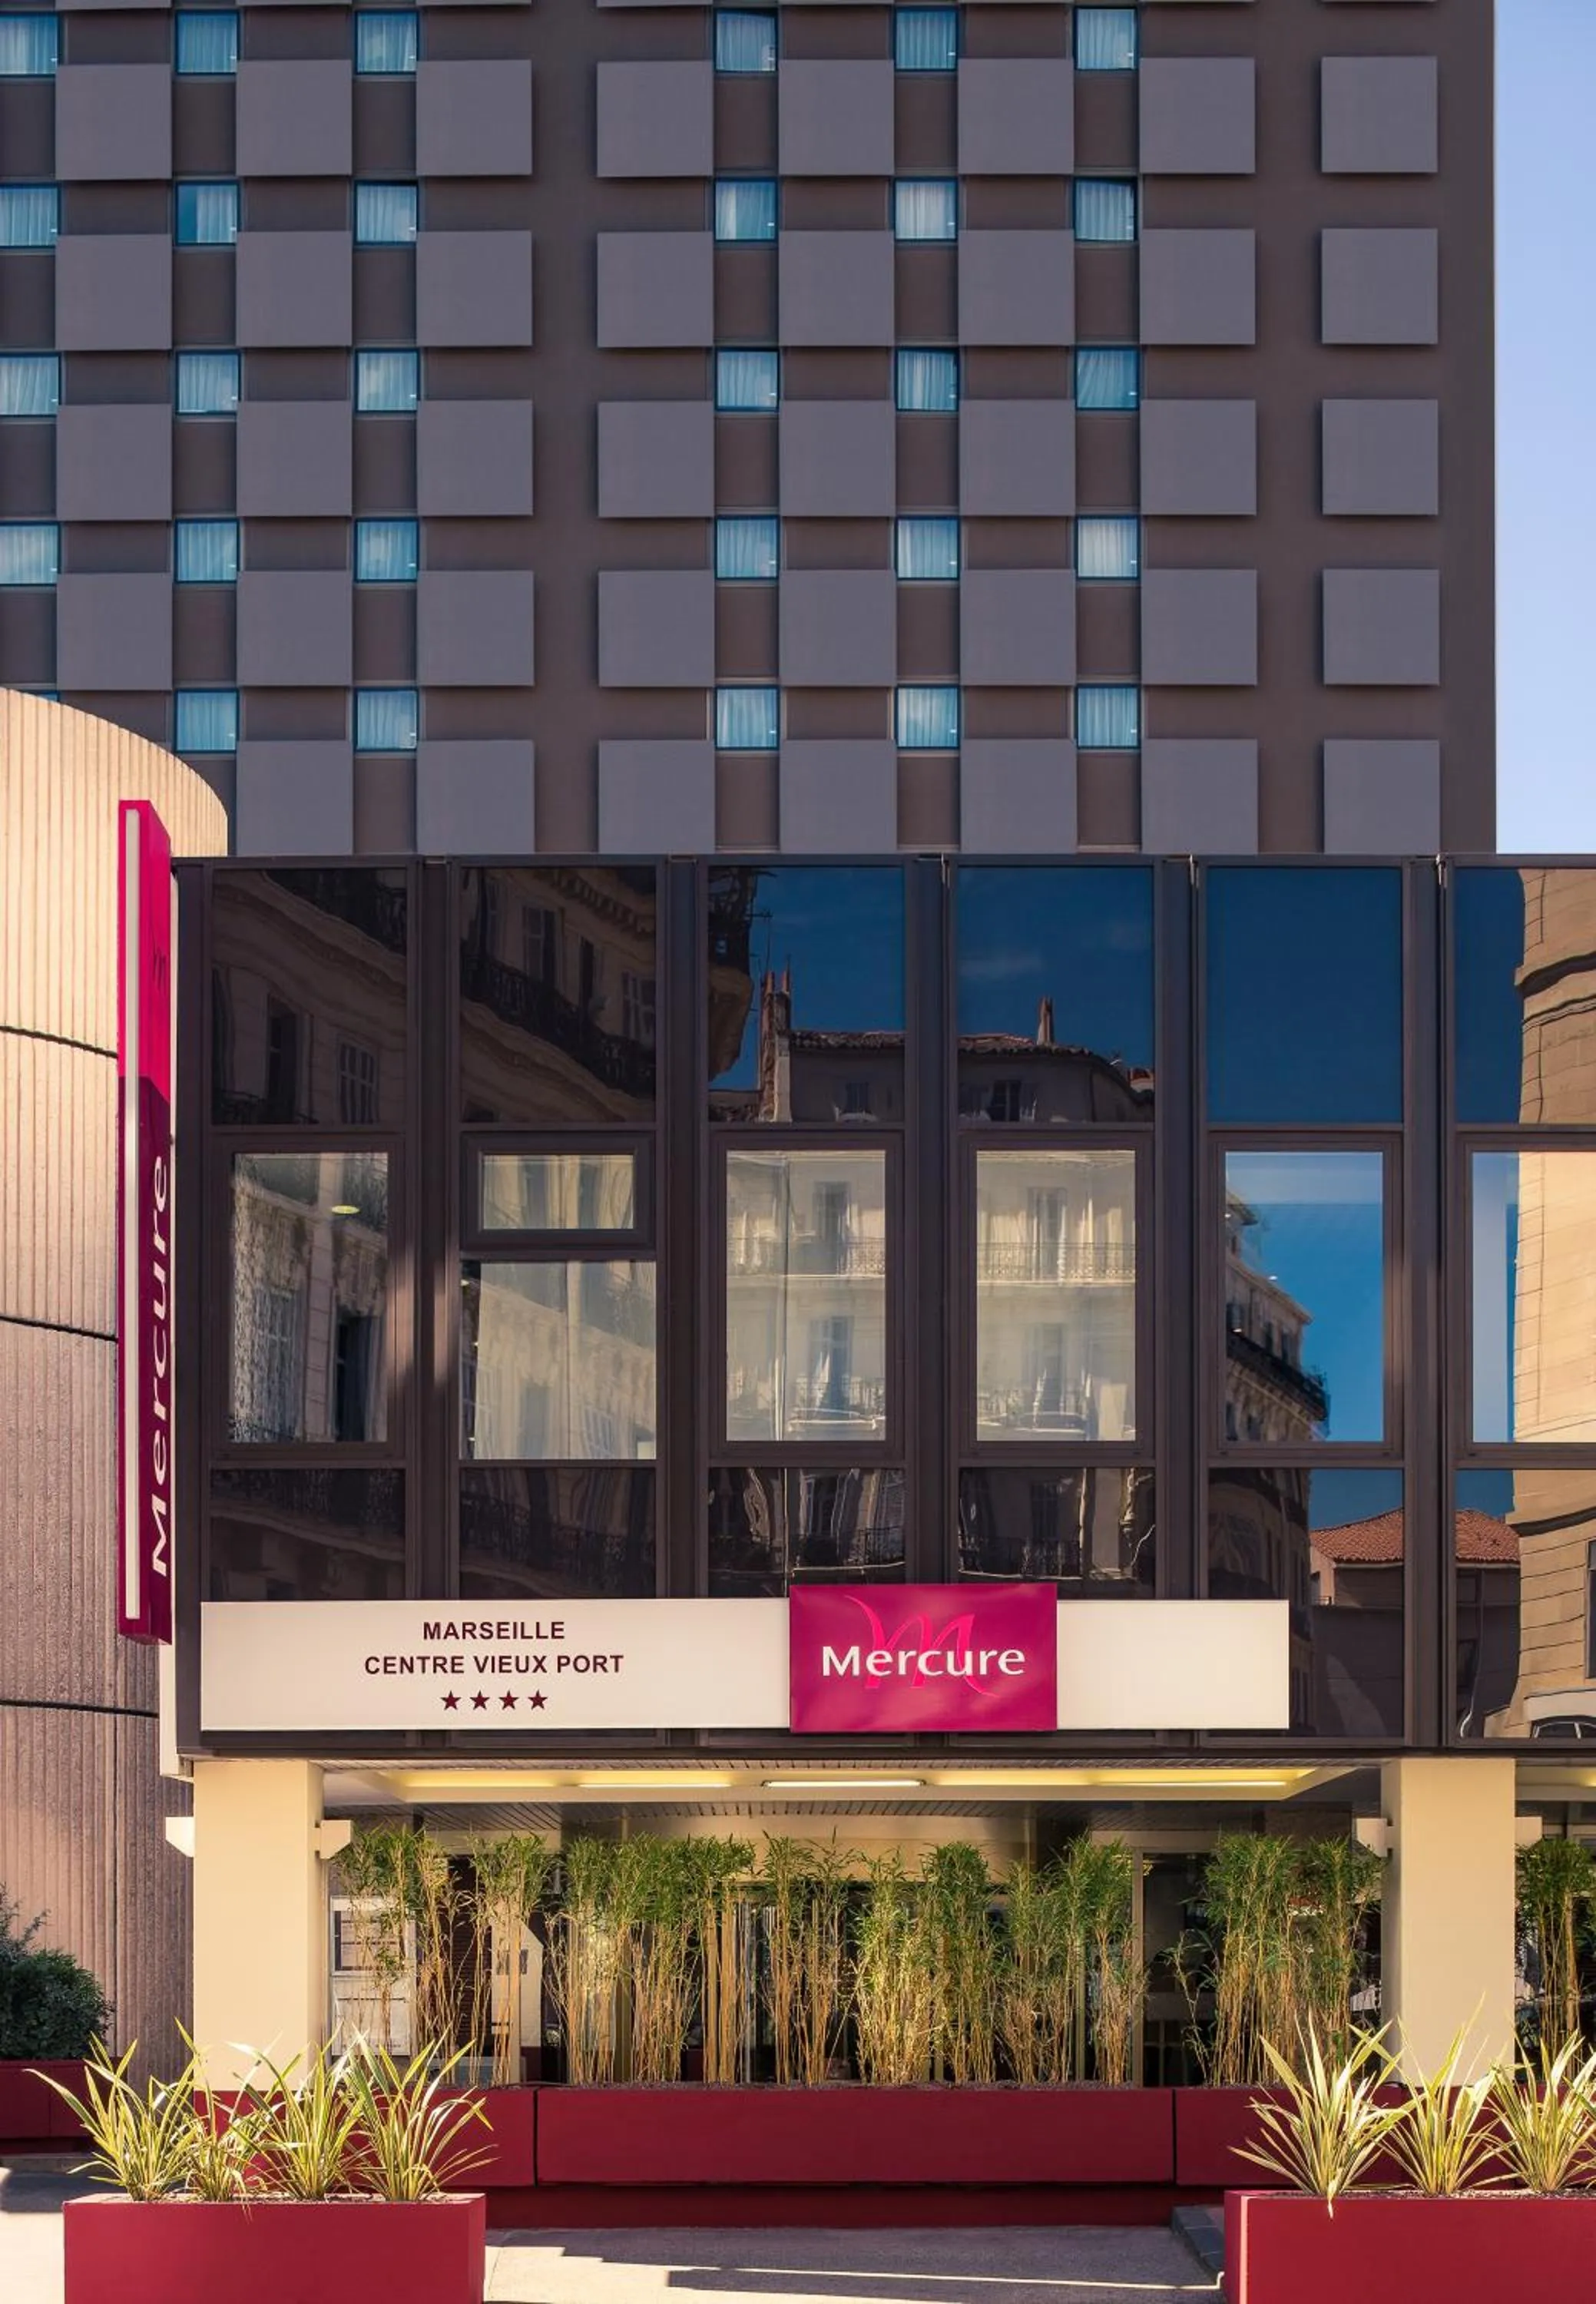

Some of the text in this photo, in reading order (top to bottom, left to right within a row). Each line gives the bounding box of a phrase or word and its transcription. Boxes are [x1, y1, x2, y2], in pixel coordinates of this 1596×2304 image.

[152, 1156, 167, 1577] Mercure
[422, 1621, 565, 1640] MARSEILLE
[364, 1654, 624, 1675] CENTRE VIEUX PORT
[822, 1646, 1026, 1677] Mercure
